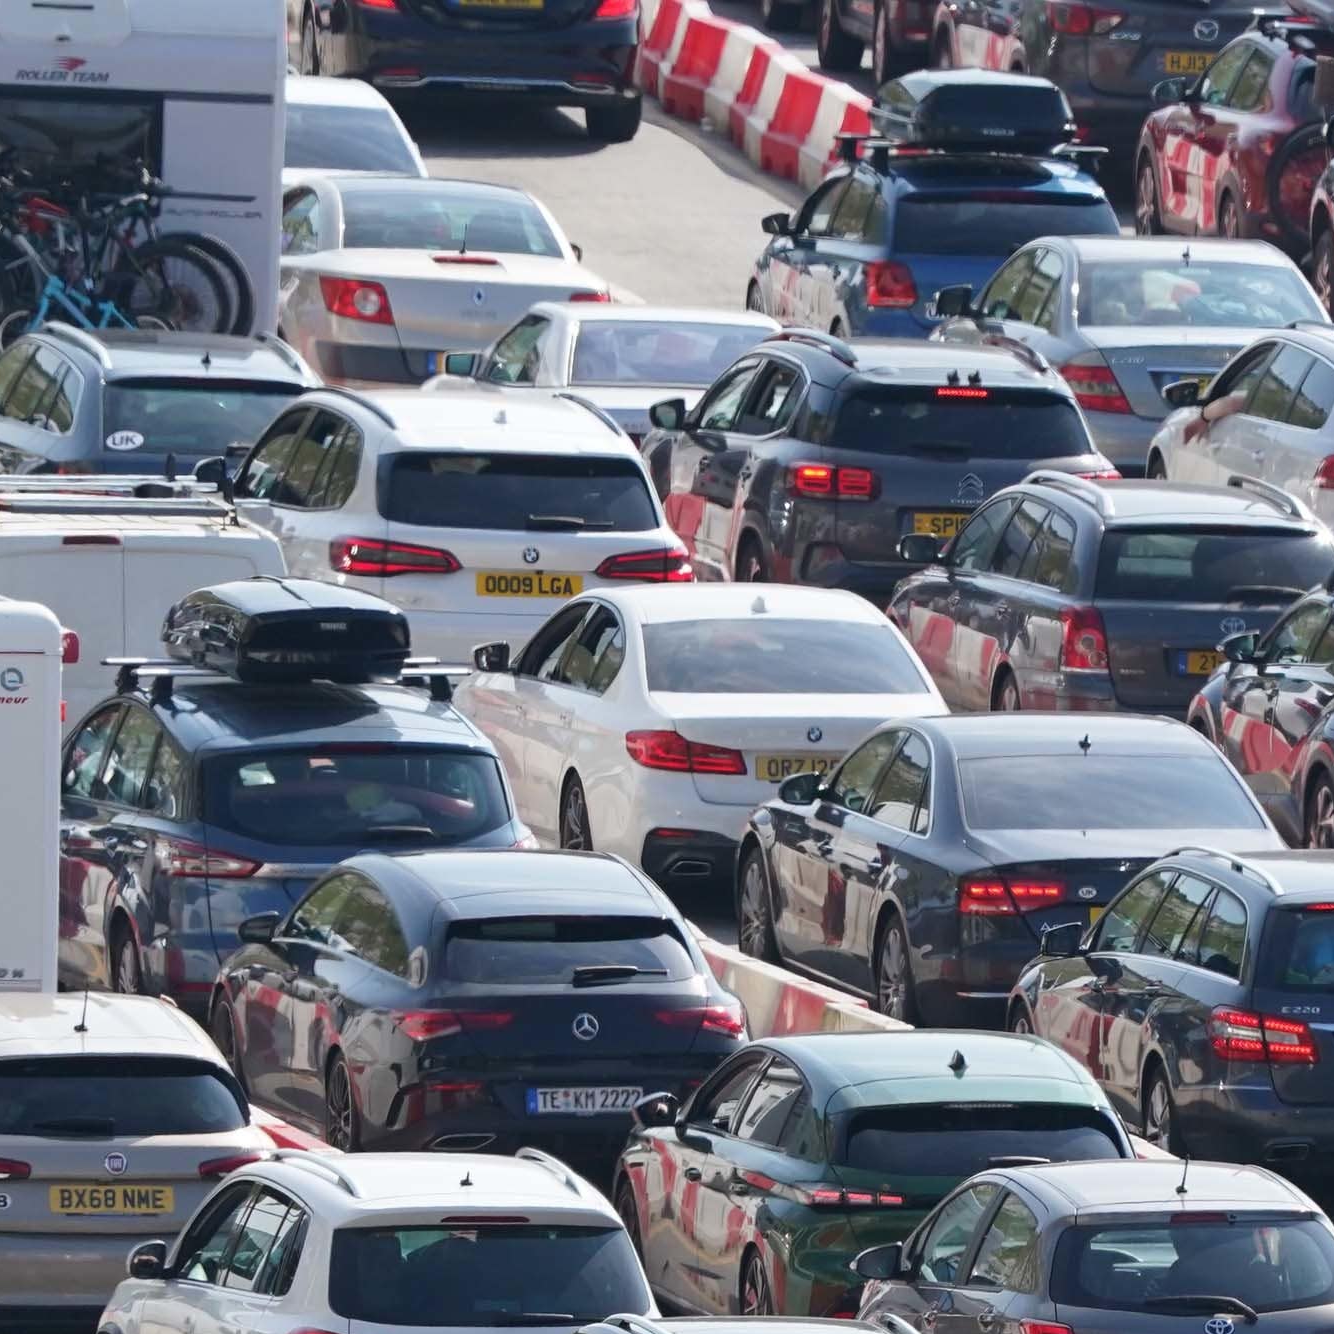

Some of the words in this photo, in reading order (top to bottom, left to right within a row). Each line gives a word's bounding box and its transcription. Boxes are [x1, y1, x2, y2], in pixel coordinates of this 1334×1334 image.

[16, 69, 66, 81] ROLLER
[72, 71, 110, 83] TEAM
[112, 434, 137, 447] UK
[538, 577, 574, 595] LGA
[540, 1090, 562, 1109] TE
[573, 1091, 596, 1109] KM
[59, 1188, 116, 1209] BX68
[122, 1189, 165, 1208] NME
